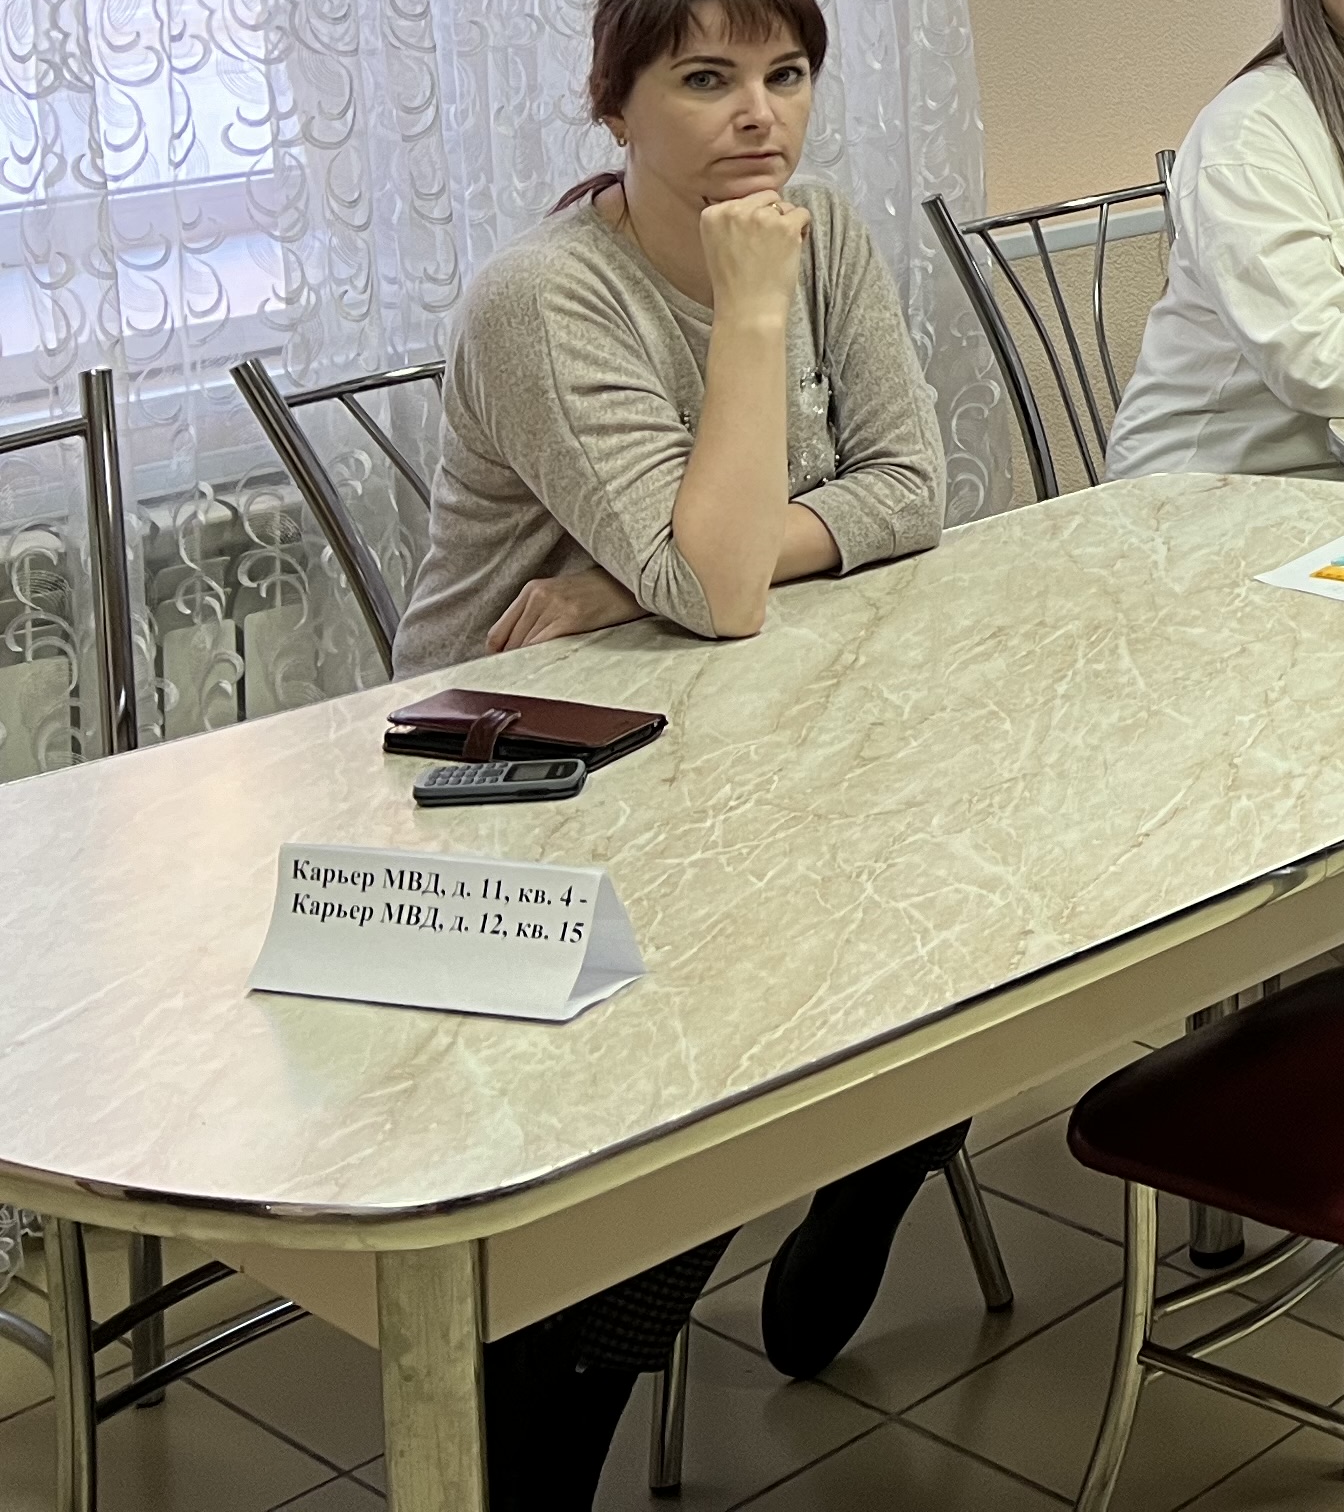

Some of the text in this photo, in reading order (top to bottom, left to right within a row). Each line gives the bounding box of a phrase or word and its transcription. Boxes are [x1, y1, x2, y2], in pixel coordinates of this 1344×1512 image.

[292, 858, 375, 893] Карьер
[383, 867, 446, 898] МВД,
[451, 879, 472, 899] д.
[482, 877, 510, 904] 11,
[518, 886, 552, 906] кв.
[559, 884, 574, 908] 4
[291, 892, 584, 944] Карьер МВД, д. 12, кв. 15
